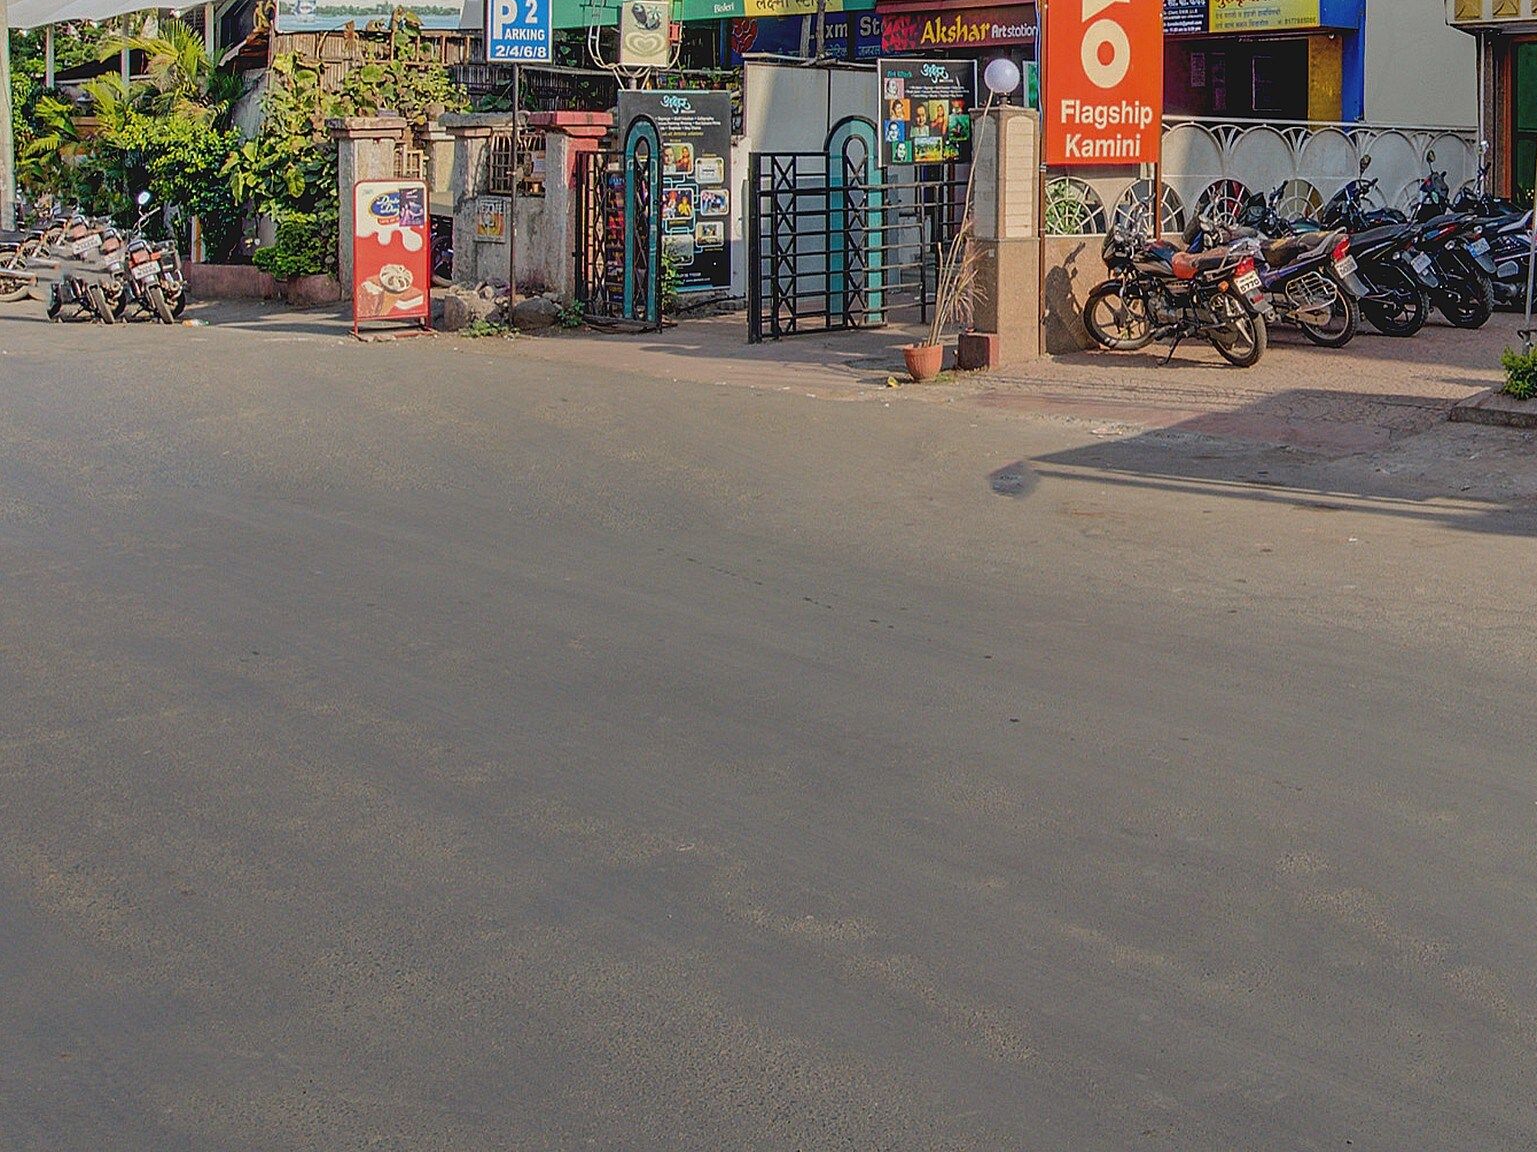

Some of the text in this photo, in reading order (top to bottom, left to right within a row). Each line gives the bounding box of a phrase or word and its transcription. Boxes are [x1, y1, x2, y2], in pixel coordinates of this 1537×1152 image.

[920, 15, 990, 44] Akshar
[495, 45, 547, 58] 2/4/6/8
[1060, 99, 1153, 134] Flagship
[1064, 133, 1141, 159] Kamini
